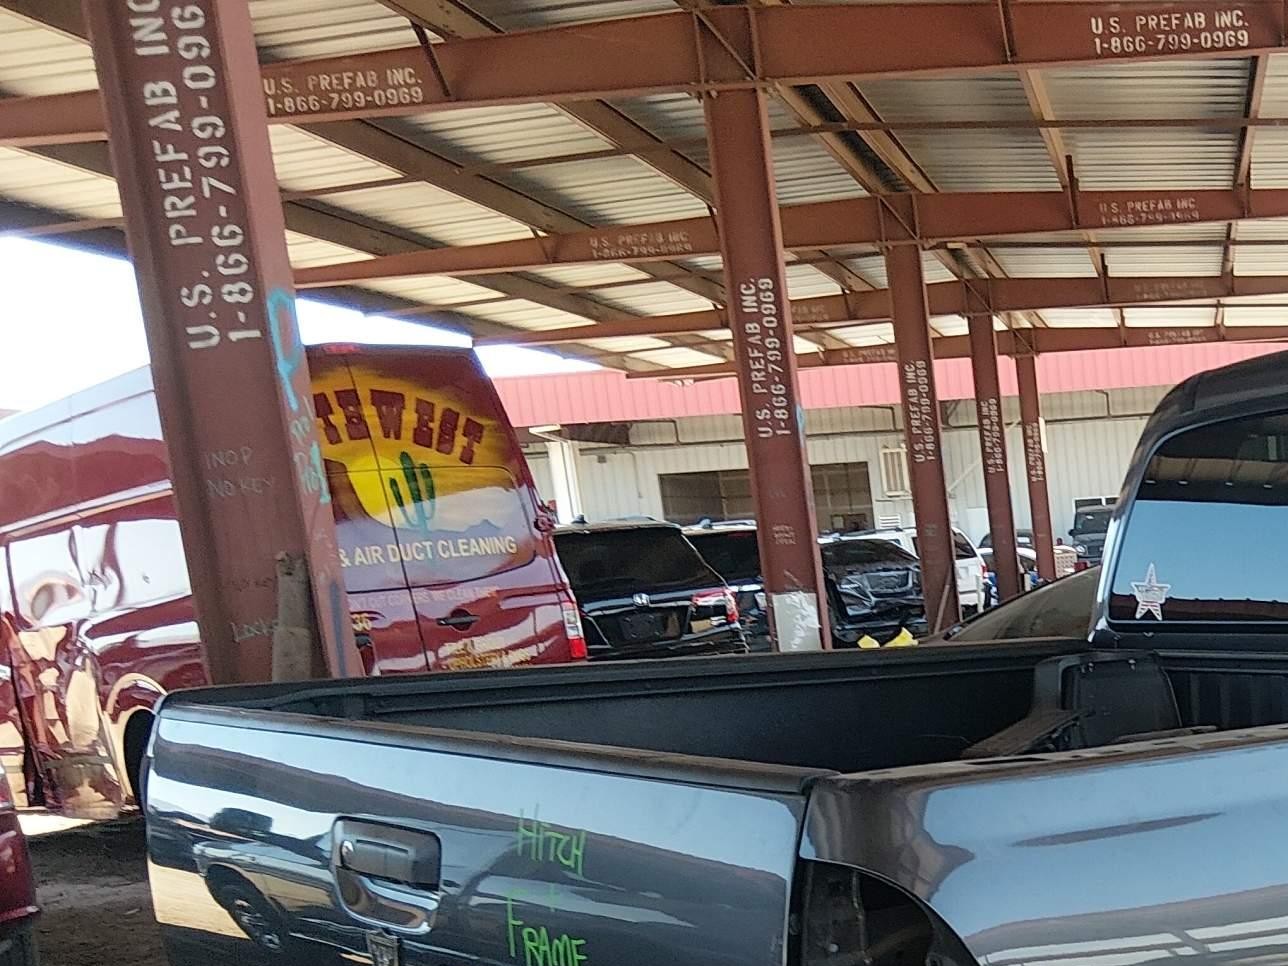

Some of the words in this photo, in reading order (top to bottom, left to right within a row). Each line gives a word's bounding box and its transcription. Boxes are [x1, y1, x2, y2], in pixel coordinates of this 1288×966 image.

[1090, 17, 1126, 34] U.S.
[1136, 12, 1206, 32] PREFAB
[1215, 10, 1249, 27] INC.
[1094, 30, 1249, 54] 1-866-799-0969
[263, 77, 299, 95] U.S.
[308, 70, 378, 92] PREFAB
[386, 67, 423, 87] INC.
[267, 87, 424, 115] 1-866-799-0969
[143, 81, 204, 246] PREFAB
[1126, 199, 1172, 213] PREFAB
[180, 271, 221, 349] U.S.
[740, 278, 759, 313] INC.
[744, 322, 768, 394] PREFAB
[758, 278, 791, 435] 1-866-799-0969
[755, 403, 774, 438] U.S.
[907, 388, 923, 435] PREFAB
[355, 545, 385, 566] AIR
[386, 540, 433, 563] DUCT
[437, 535, 518, 558] CLEANING
